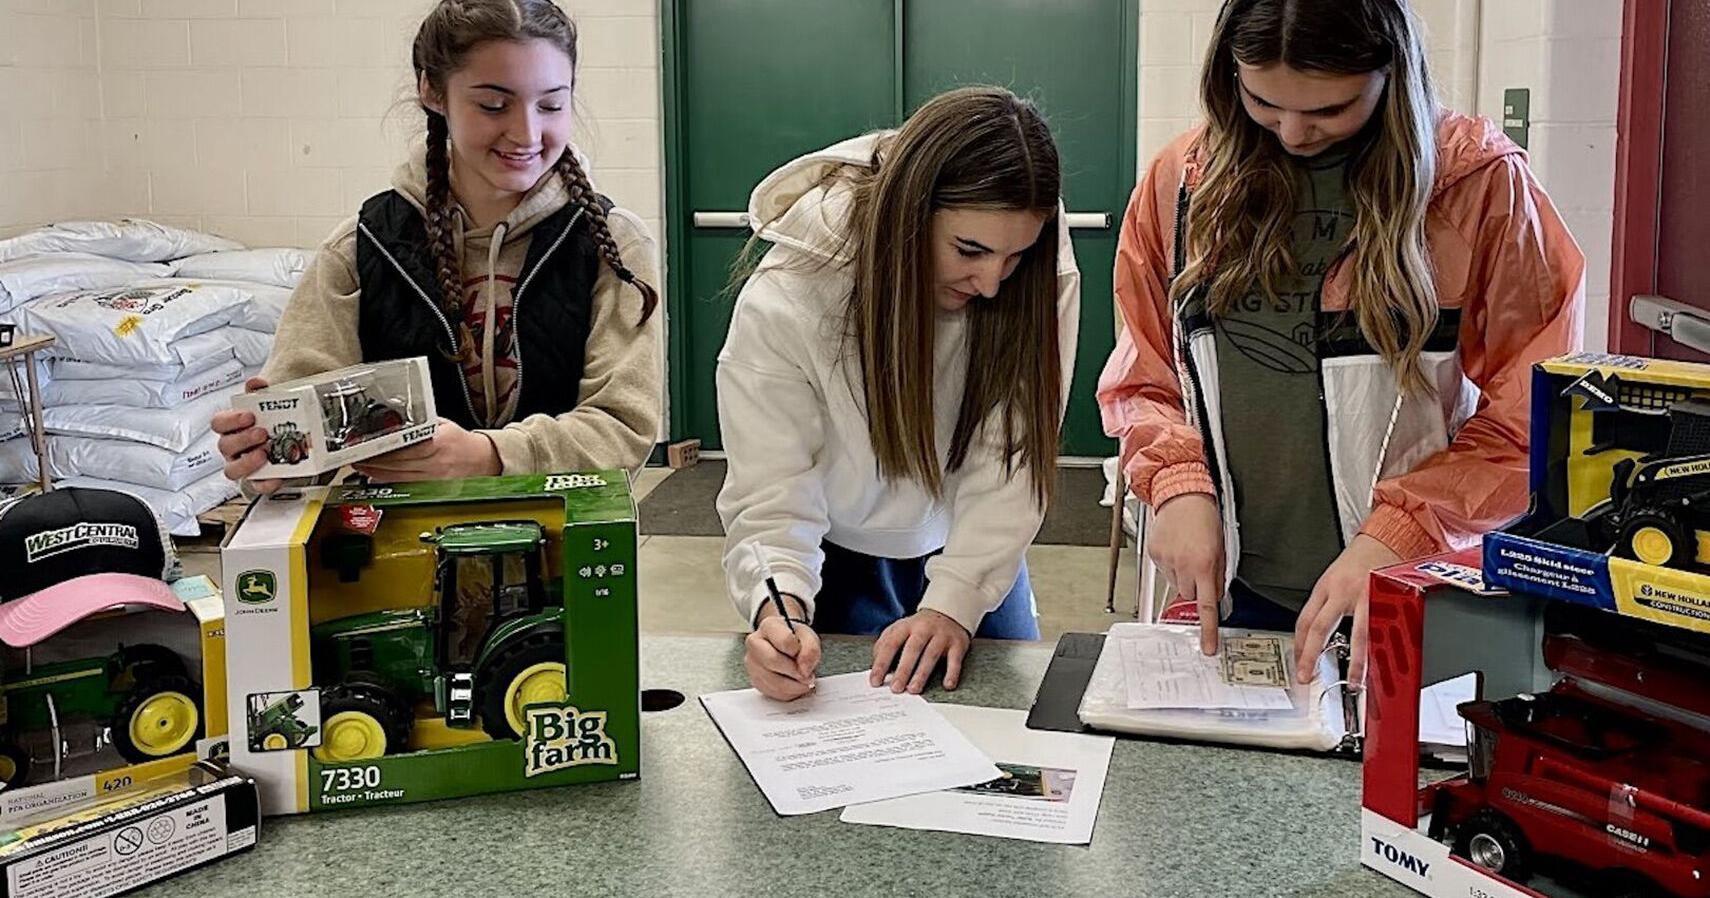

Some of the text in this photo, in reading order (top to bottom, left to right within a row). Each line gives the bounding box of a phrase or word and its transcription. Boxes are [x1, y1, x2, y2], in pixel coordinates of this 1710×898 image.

[259, 398, 299, 412] FENDT
[402, 423, 436, 443] FENDT
[1669, 466, 1690, 475] NEW
[27, 523, 137, 554] WEST CENTRAL
[593, 538, 609, 551] 3+
[1501, 548, 1533, 562] L225
[1533, 556, 1562, 569] Skid
[1497, 567, 1560, 588] glissement
[1513, 562, 1570, 581] Chargeur
[1654, 589, 1676, 600] NEW
[533, 710, 602, 744] Big
[531, 740, 613, 770] farm
[103, 775, 132, 791] 420
[320, 765, 381, 792] 7330
[321, 789, 404, 804] Tractor Tracteur
[1371, 837, 1431, 878] TOMY
